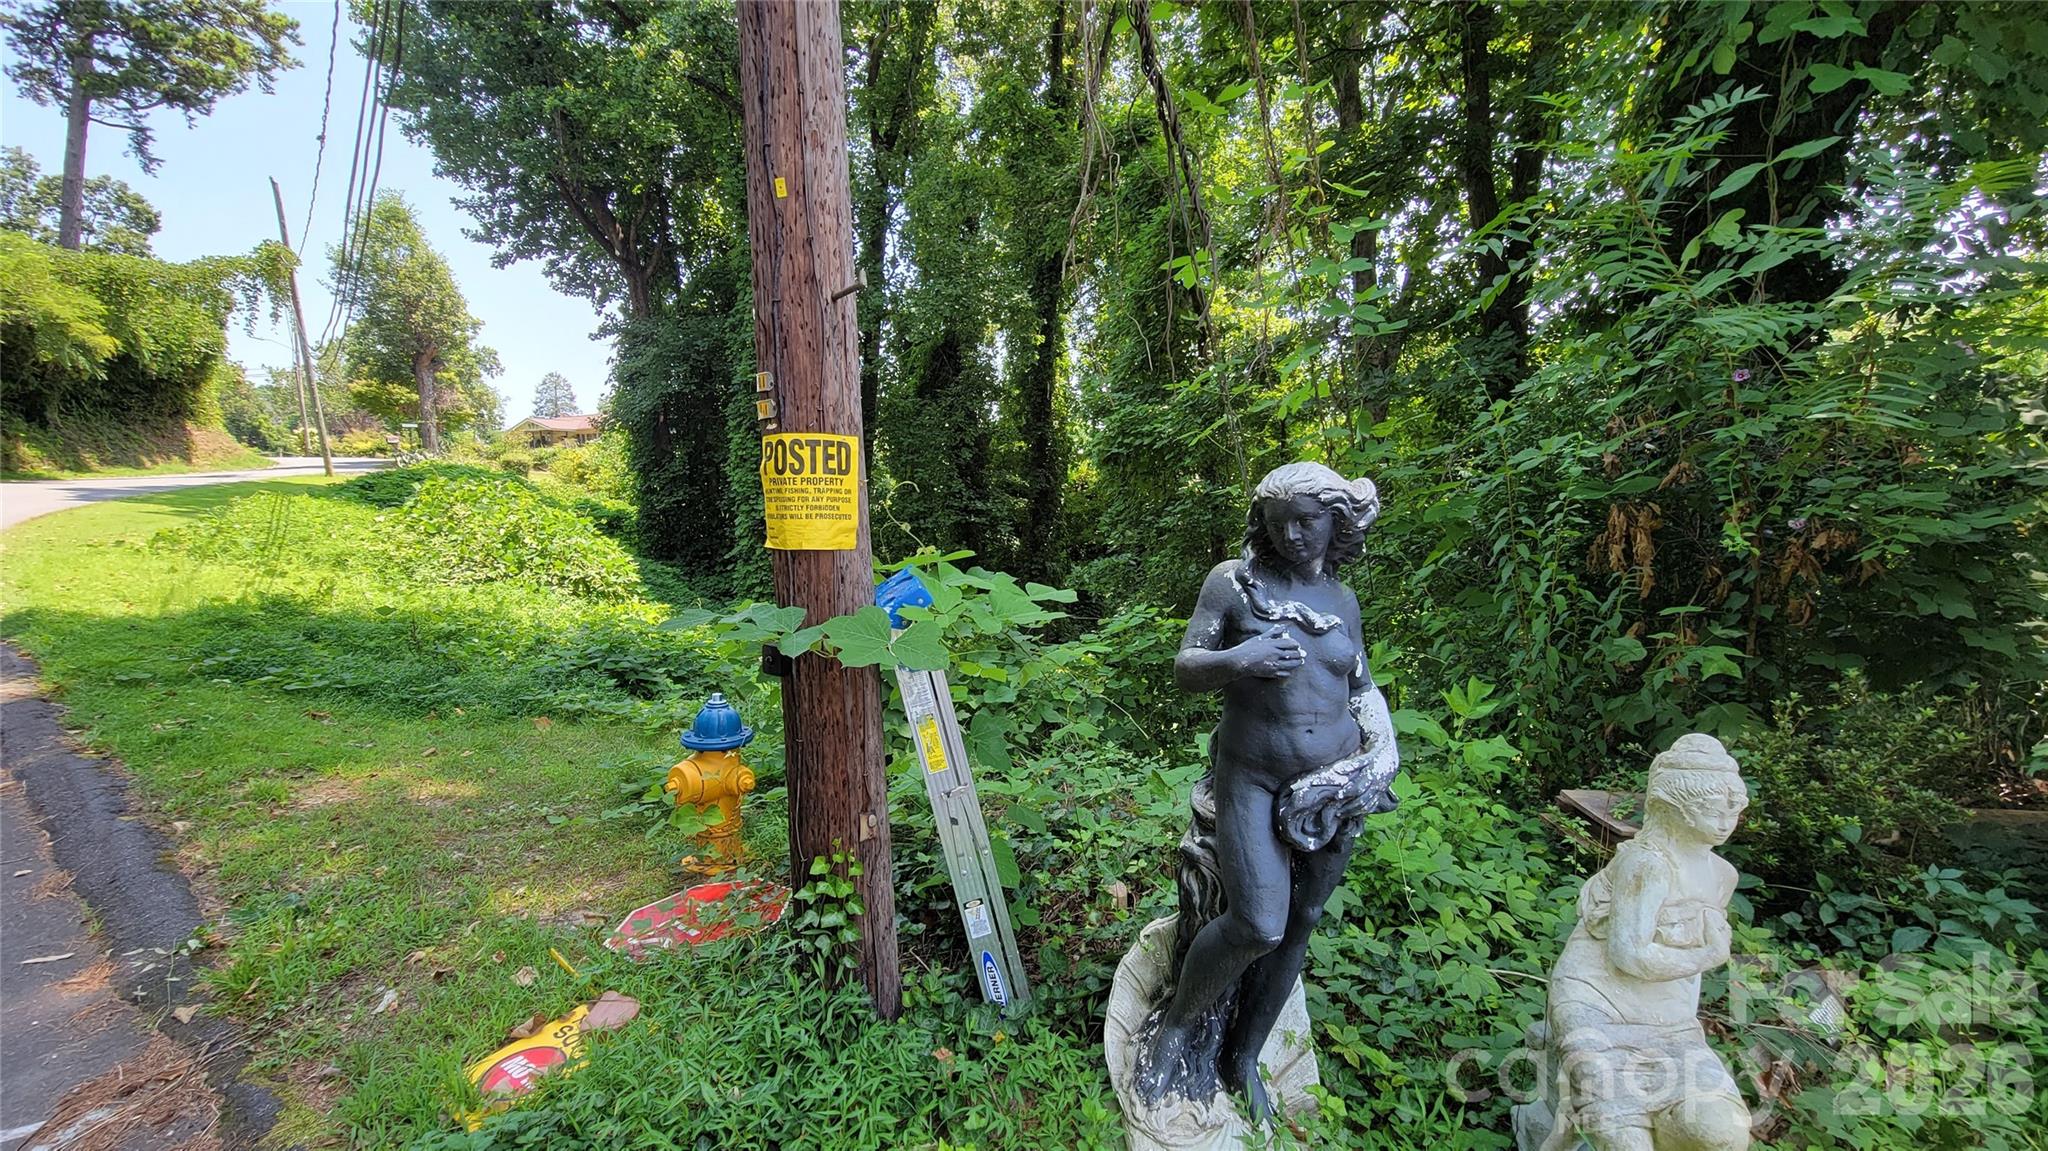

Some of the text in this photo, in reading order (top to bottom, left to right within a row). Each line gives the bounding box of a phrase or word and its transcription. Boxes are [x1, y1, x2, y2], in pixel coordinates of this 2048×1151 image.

[764, 438, 851, 476] POSTED
[769, 477, 844, 487] PRIVATE PROPERTY
[813, 487, 843, 495] TRAPPING
[826, 496, 852, 504] PURPOSE
[775, 504, 840, 512] STRICTLY FORBIDDEN
[815, 513, 853, 521] PROSECUTED
